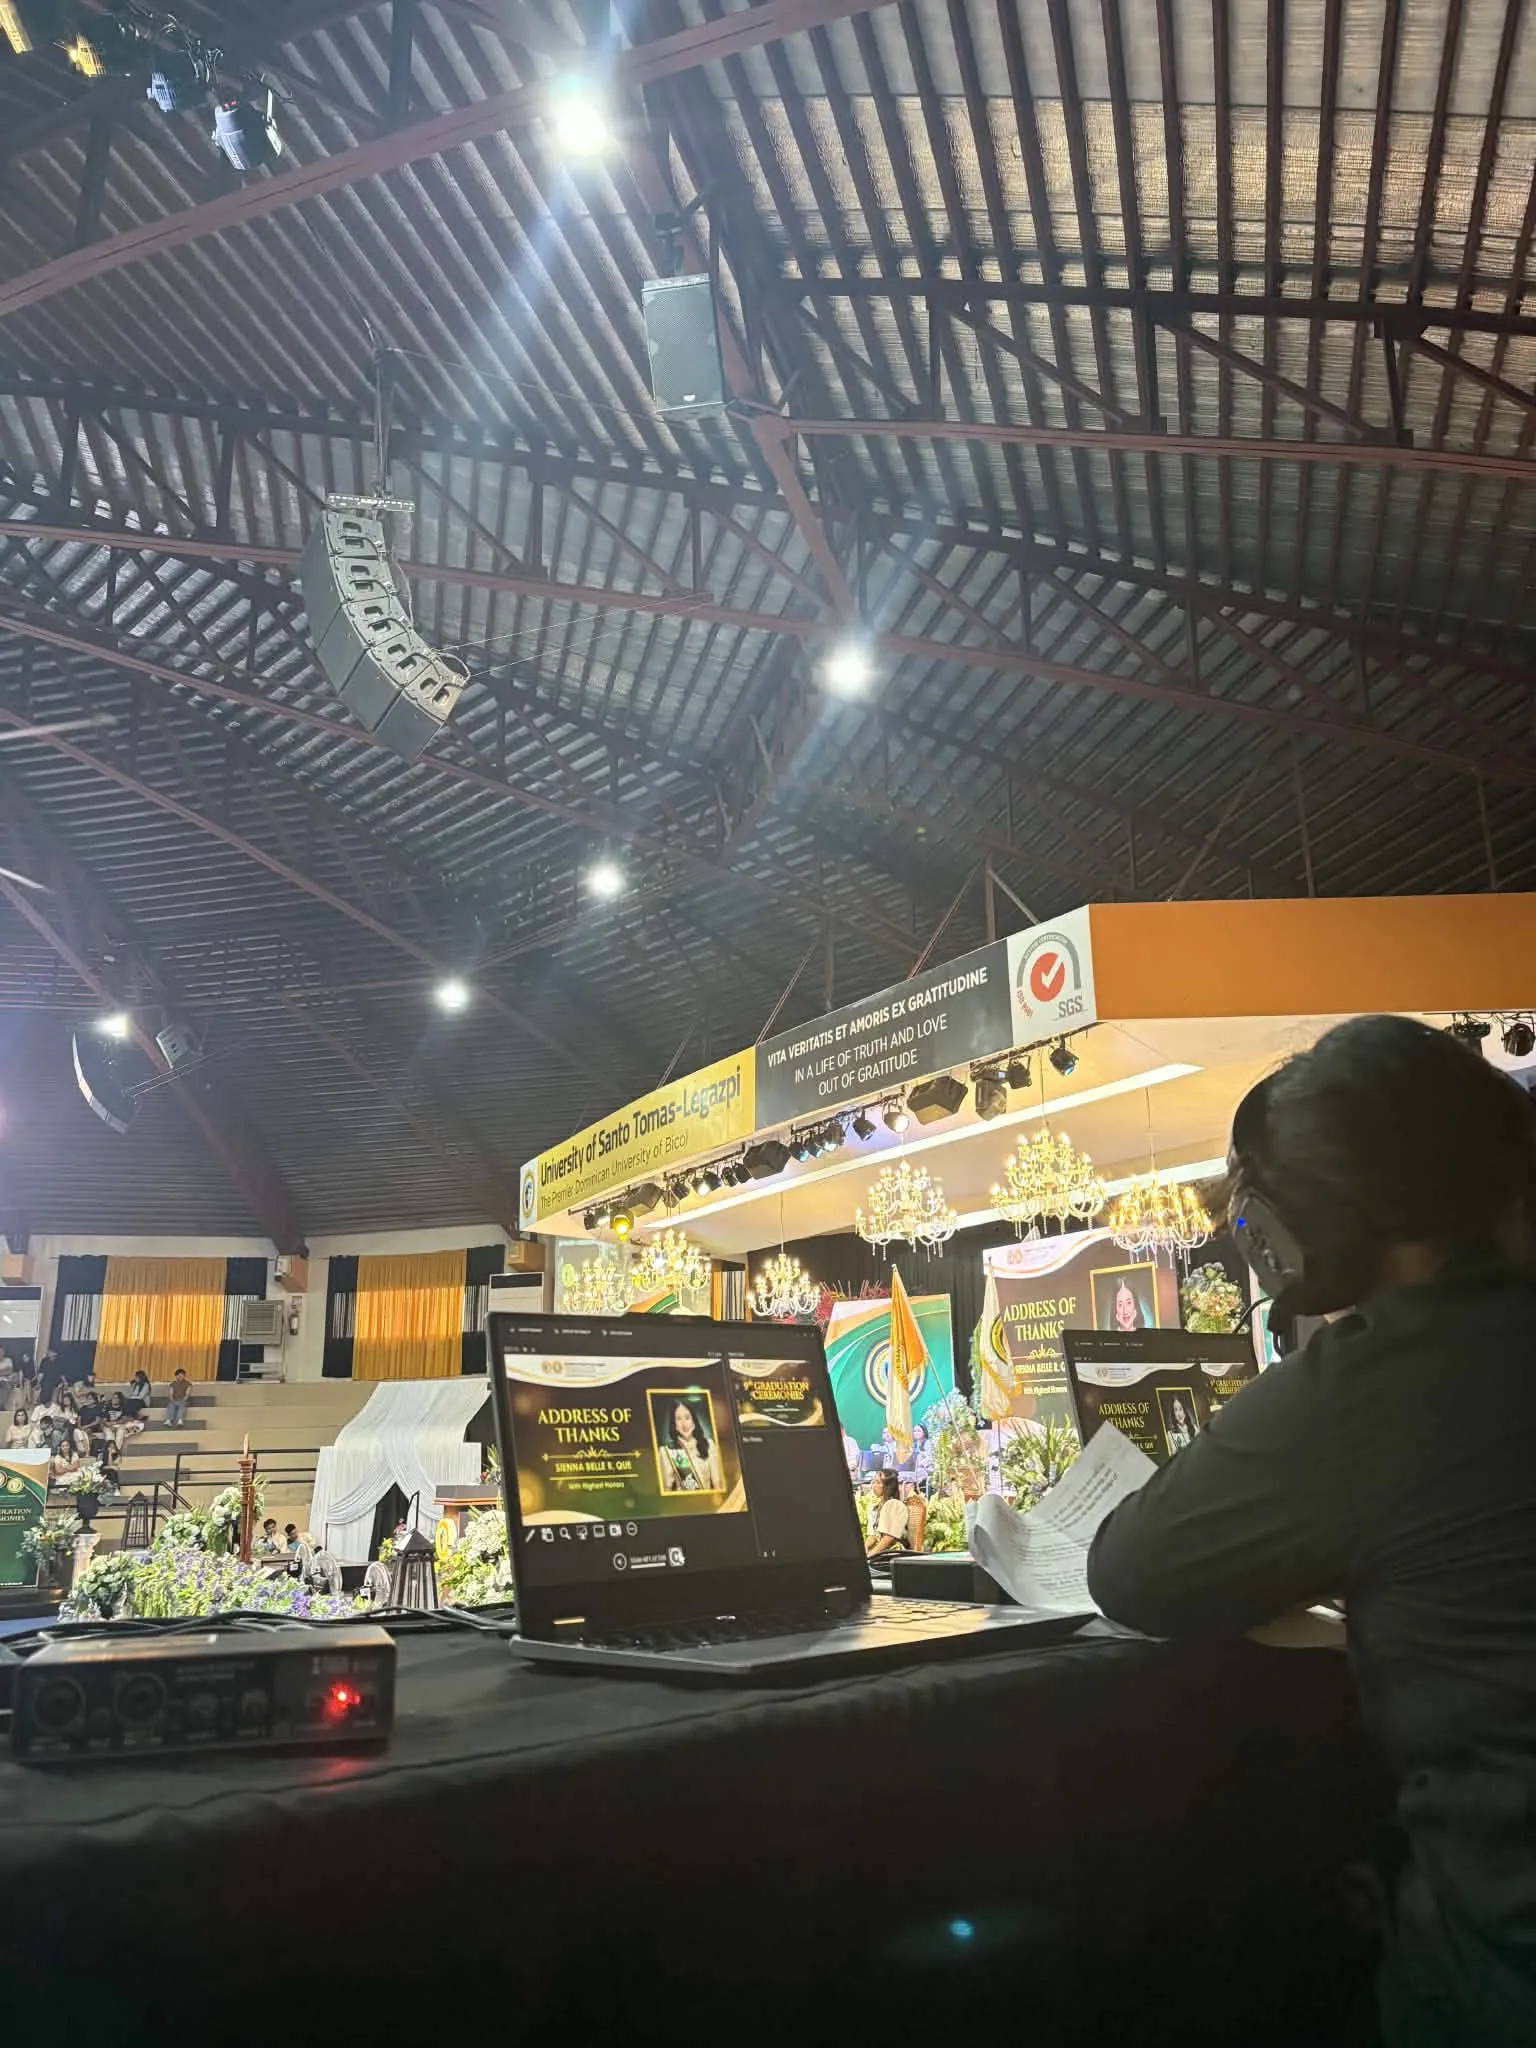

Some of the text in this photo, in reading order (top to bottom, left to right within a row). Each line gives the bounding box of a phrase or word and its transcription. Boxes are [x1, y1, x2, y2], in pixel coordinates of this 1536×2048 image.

[767, 1046, 787, 1069] VITA
[788, 1025, 834, 1060] VERITATIS
[835, 1022, 848, 1041] ET
[849, 1007, 890, 1037] AMORIS
[891, 999, 907, 1019] EX
[908, 966, 989, 1012] GRATITUDINE
[1058, 995, 1083, 1018] SGS
[794, 1013, 948, 1084] IN A LIFE OF TRUTH AND LOVE
[819, 1048, 918, 1097] OUT OF GRATITUDE
[540, 1066, 741, 1186] University of Santo Tomas-Legazpi
[575, 1168, 610, 1195] Dominican
[611, 1148, 651, 1177] University
[653, 1142, 663, 1157] of
[665, 1129, 688, 1153] Bicol
[1003, 1297, 1077, 1322] ADDRESS OF
[1014, 1319, 1065, 1342] THANKS
[754, 1381, 809, 1391] GRADUATION
[538, 1407, 632, 1425] ADDRESS OF
[1099, 1402, 1150, 1416] ADDRESS OF
[555, 1426, 620, 1444] THANKS
